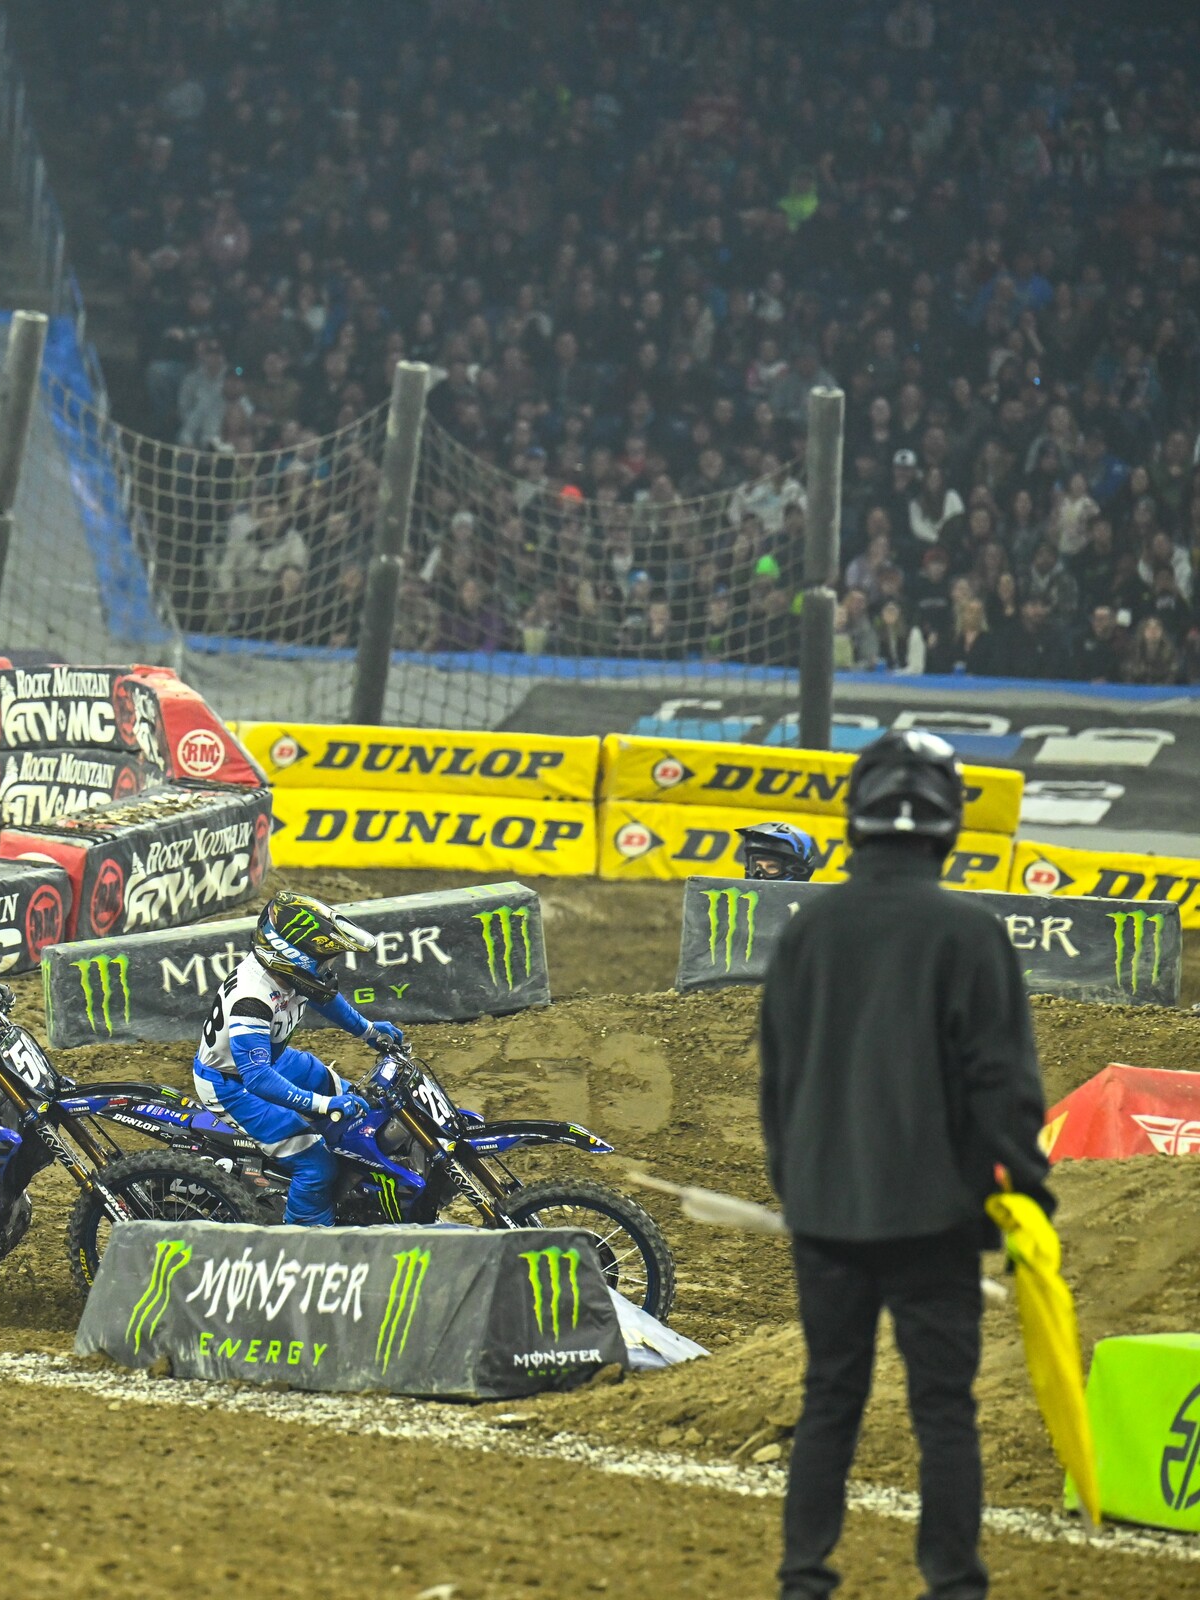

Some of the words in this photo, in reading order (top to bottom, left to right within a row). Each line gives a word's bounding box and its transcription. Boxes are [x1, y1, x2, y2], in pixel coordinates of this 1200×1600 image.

[15, 670, 50, 698] ROCKY
[53, 668, 110, 698] MOUNTAIN
[314, 741, 564, 779] DUNLOP
[296, 809, 584, 851] DUNLOP
[112, 1113, 160, 1132] DUNLOP
[186, 1247, 368, 1324] MONSTER
[199, 1332, 329, 1367] ENERGY
[513, 1349, 603, 1368] MONSTER
